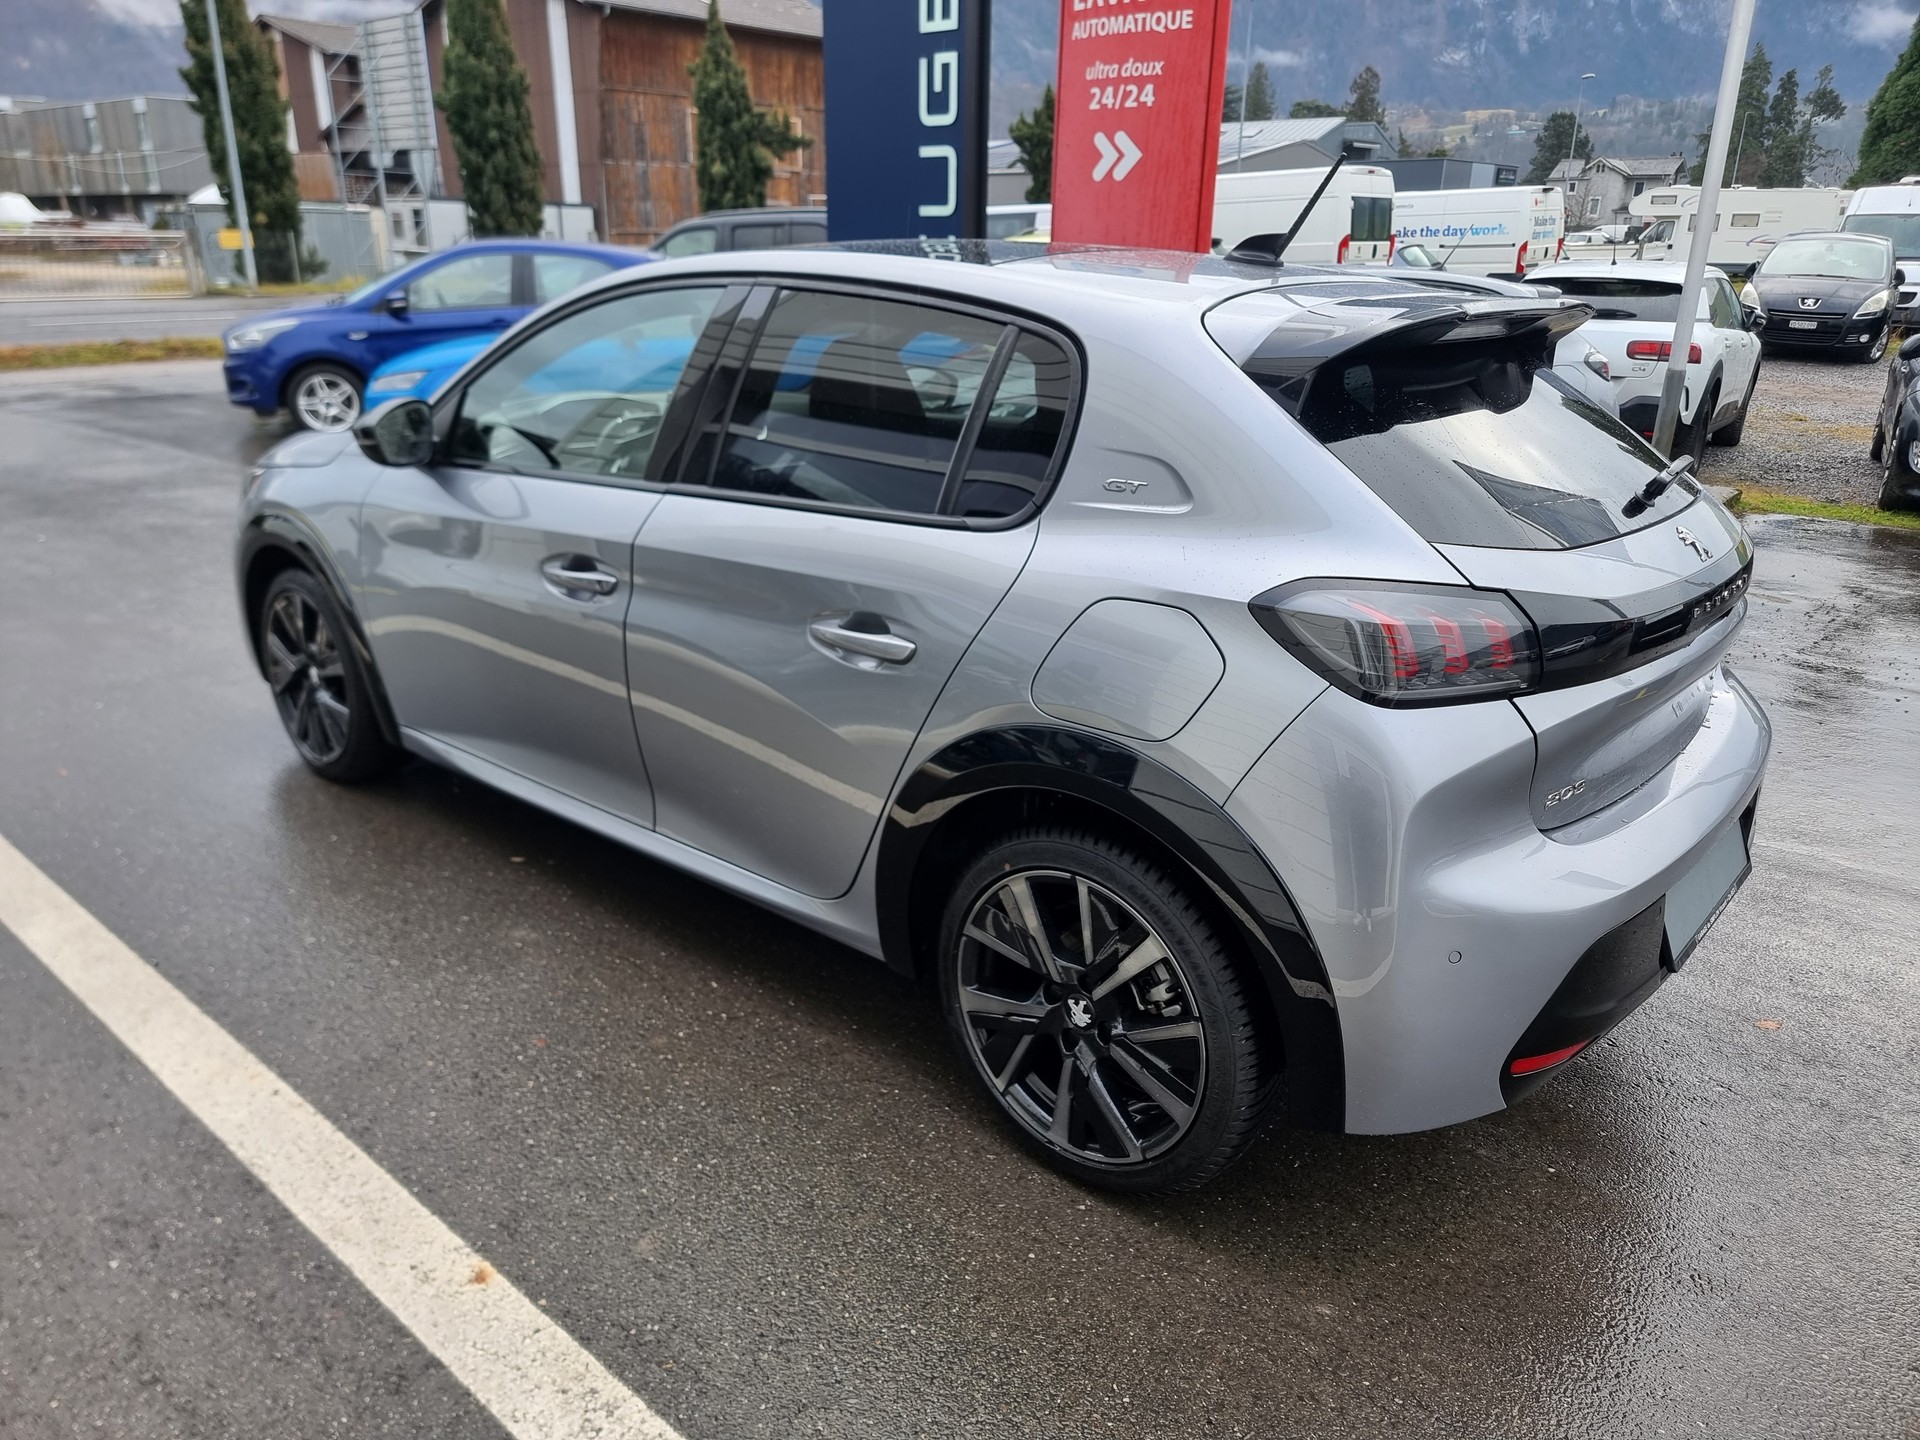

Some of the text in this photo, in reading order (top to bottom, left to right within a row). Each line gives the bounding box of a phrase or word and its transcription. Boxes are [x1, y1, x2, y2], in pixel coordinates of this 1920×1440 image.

[1071, 9, 1194, 41] AUTOMATIQUE
[1085, 57, 1164, 81] ultra doux
[1089, 83, 1155, 110] 24/24
[1394, 226, 1417, 239] ake
[1419, 226, 1440, 238] the
[1442, 225, 1468, 240] day
[1102, 478, 1149, 495] GT
